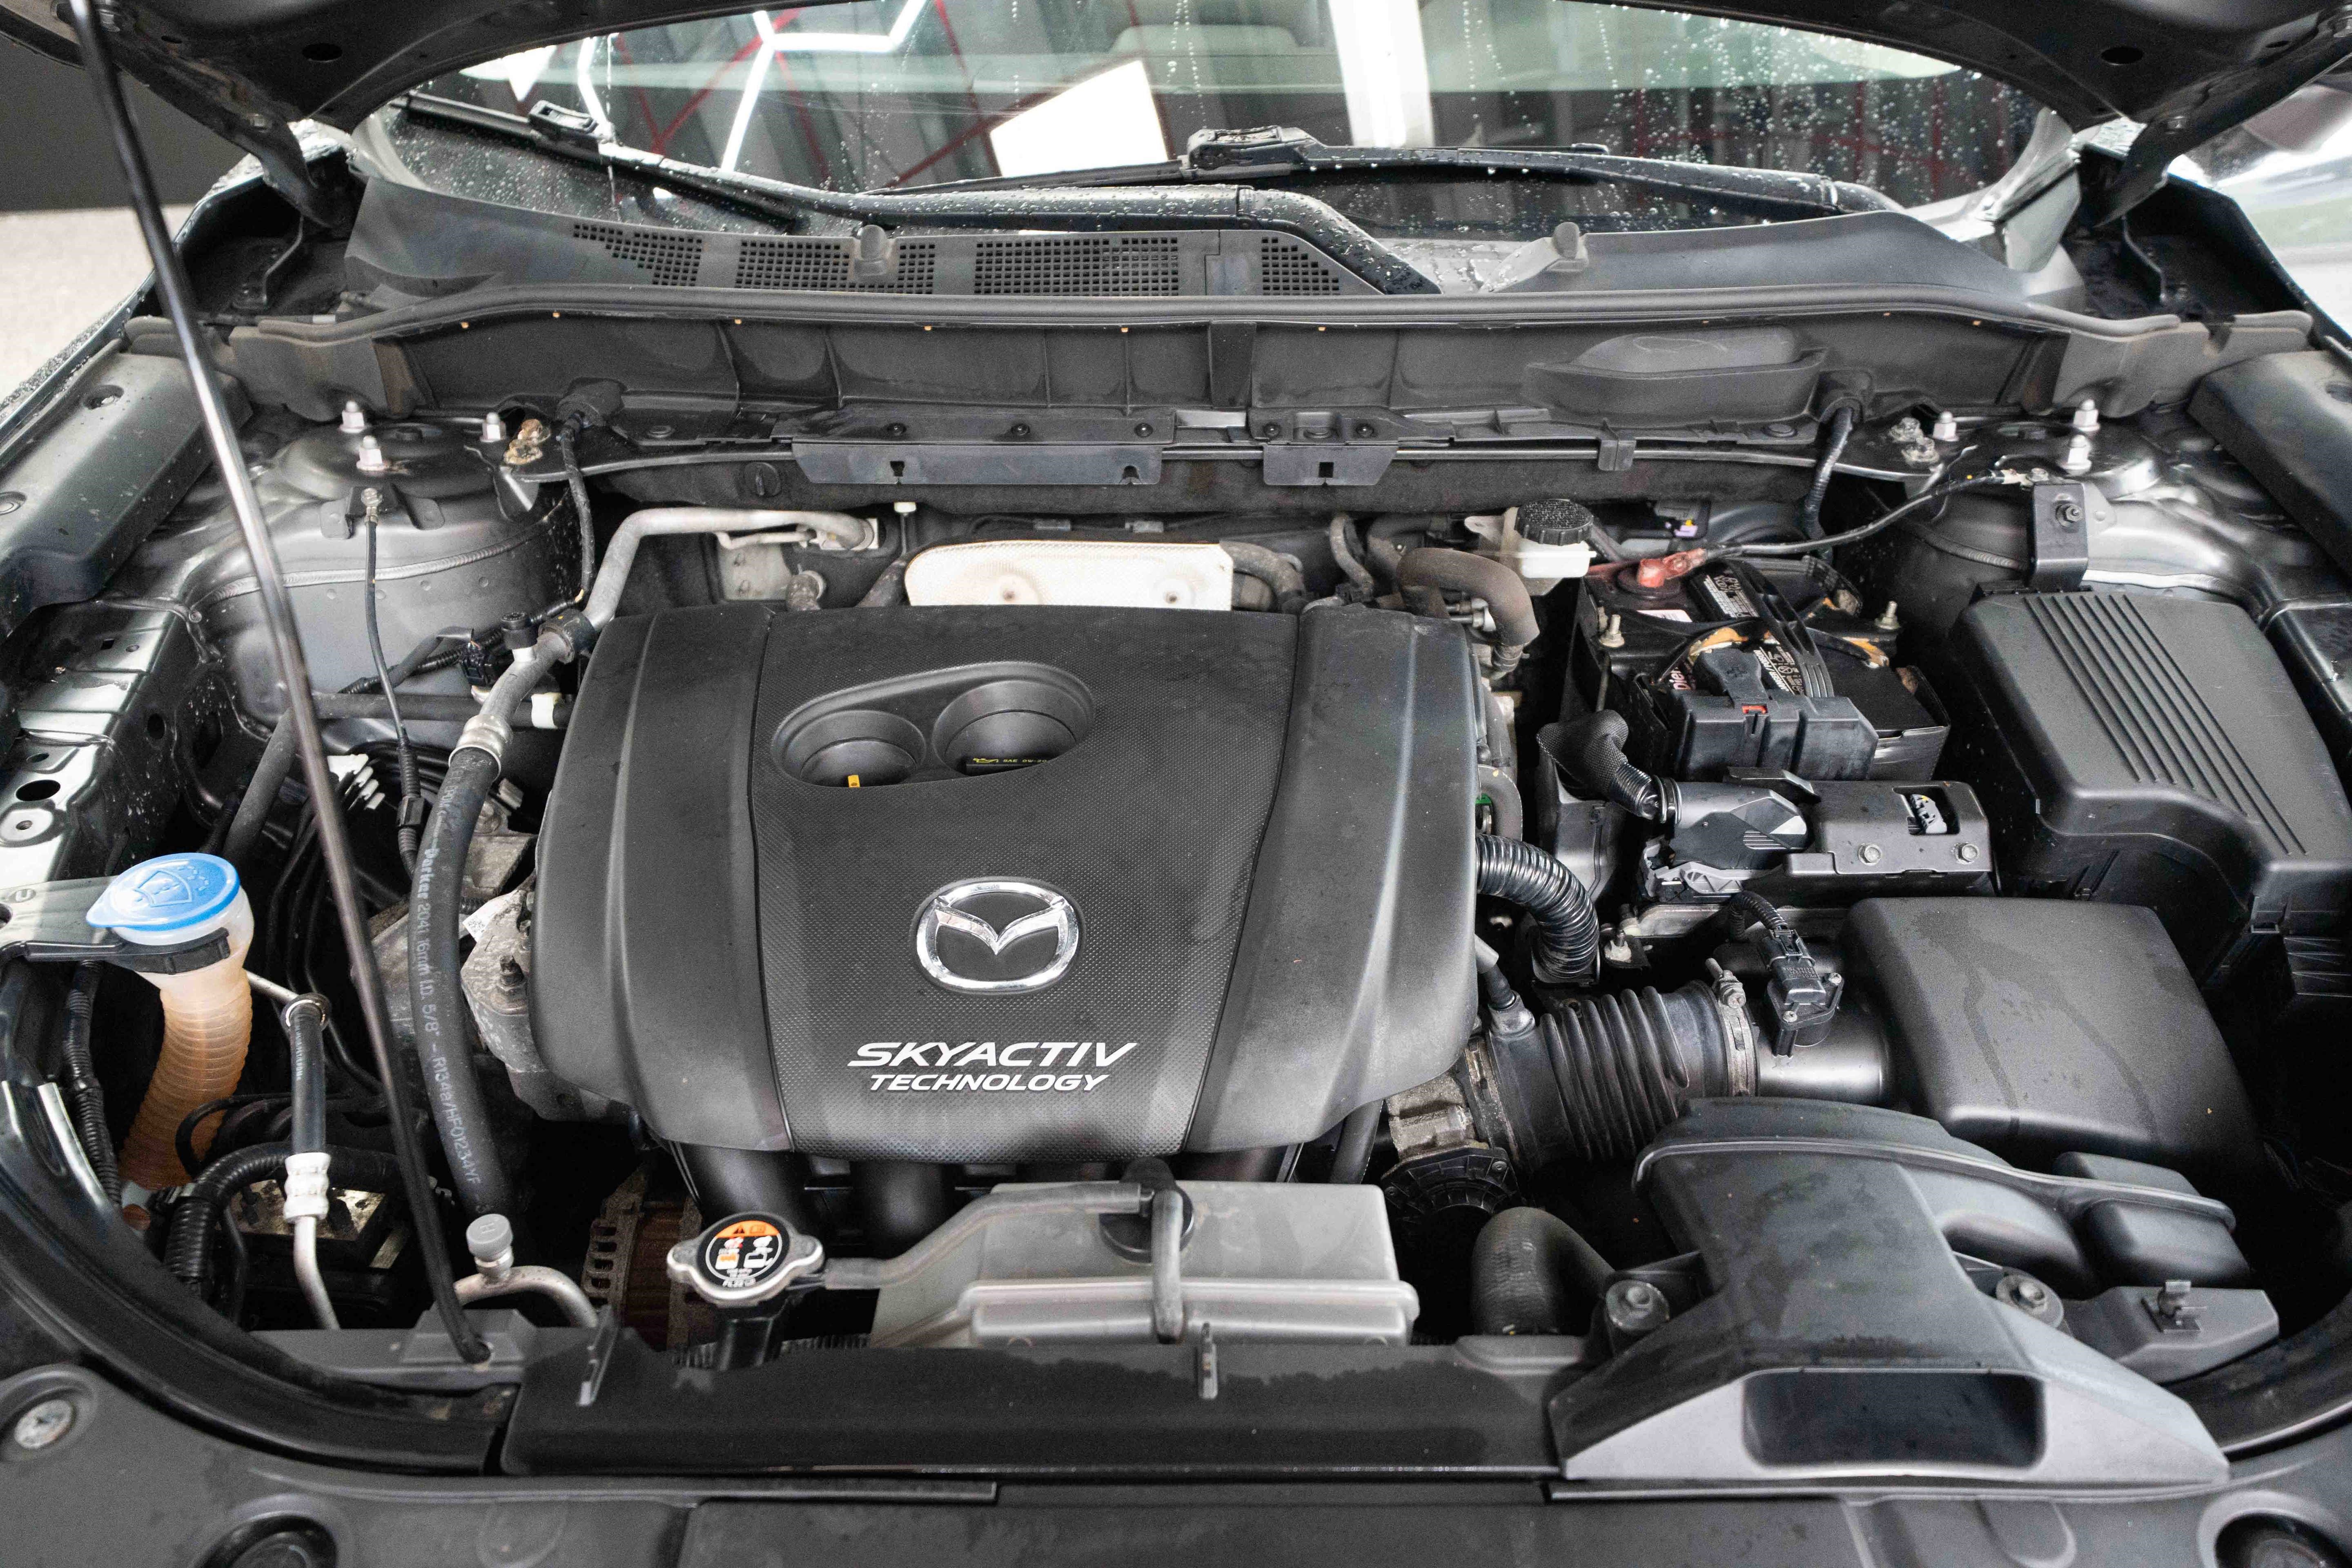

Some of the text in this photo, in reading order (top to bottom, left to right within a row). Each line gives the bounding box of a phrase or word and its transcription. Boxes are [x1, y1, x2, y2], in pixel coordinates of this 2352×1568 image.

[417, 848, 440, 899] Parker
[847, 1042, 1138, 1067] SKYACTIV
[870, 1074, 1110, 1091] TECHNOLOGY
